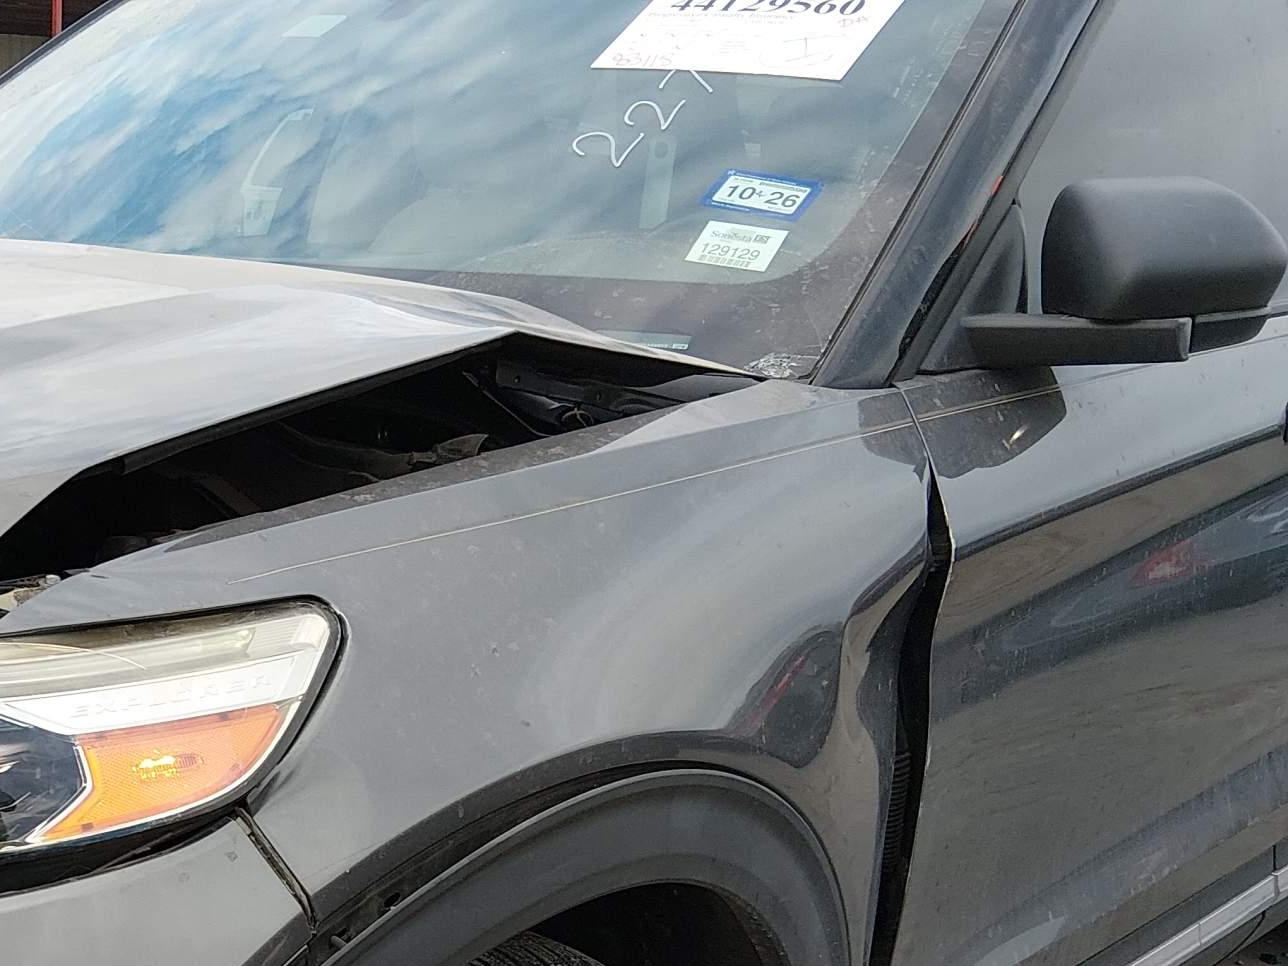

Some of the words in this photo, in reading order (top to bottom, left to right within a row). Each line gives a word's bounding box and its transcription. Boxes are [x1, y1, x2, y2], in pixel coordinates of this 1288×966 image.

[727, 184, 758, 201] 10
[764, 191, 801, 208] 26
[702, 243, 761, 261] 129129
